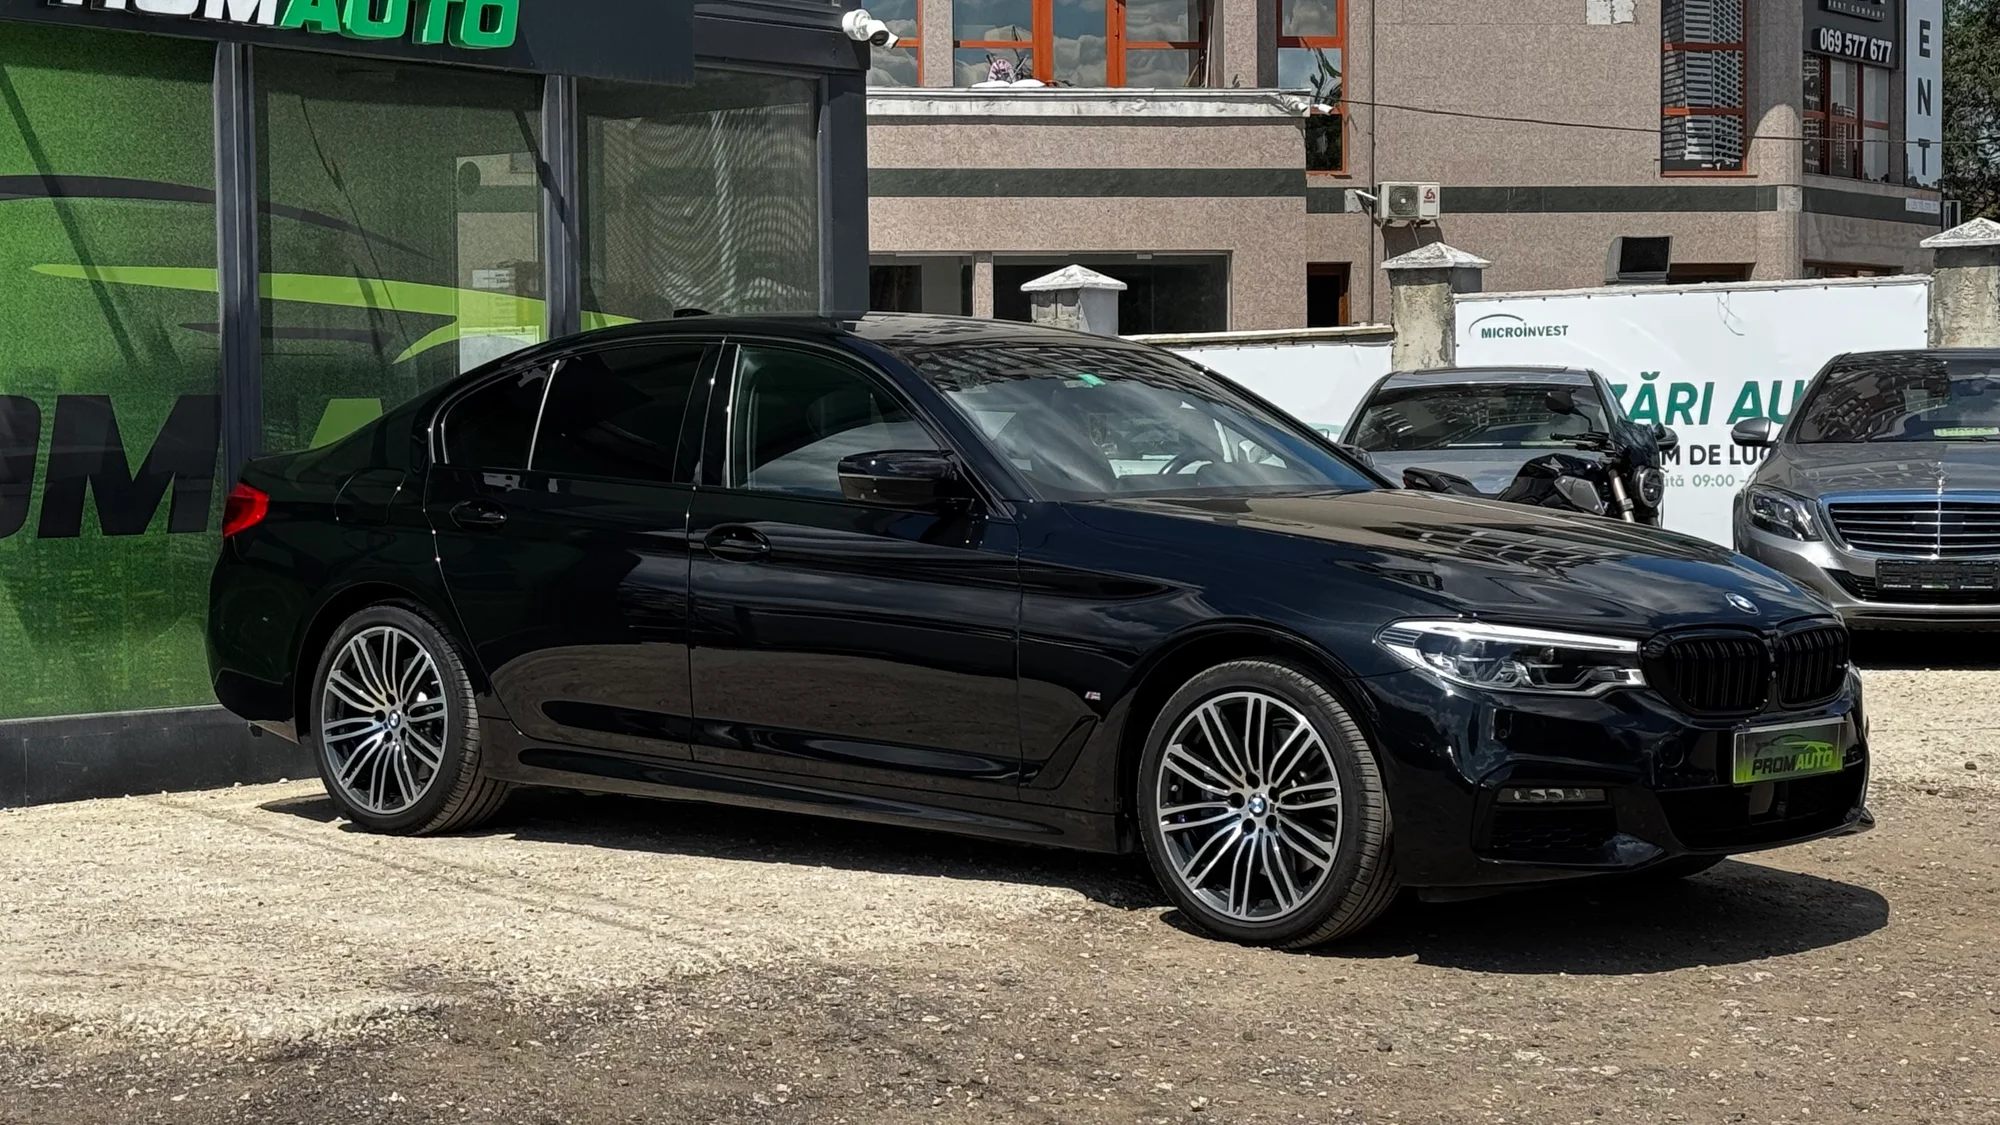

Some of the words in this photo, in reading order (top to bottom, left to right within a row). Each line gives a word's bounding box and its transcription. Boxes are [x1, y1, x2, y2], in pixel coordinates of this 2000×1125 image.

[1820, 27, 1842, 53] 069
[1845, 33, 1867, 58] 577
[1870, 38, 1892, 63] 677
[1726, 379, 1813, 425] AU
[1689, 444, 1721, 466] DE
[1692, 474, 1735, 488] 09:00
[1751, 749, 1834, 776] PROMAUTO
